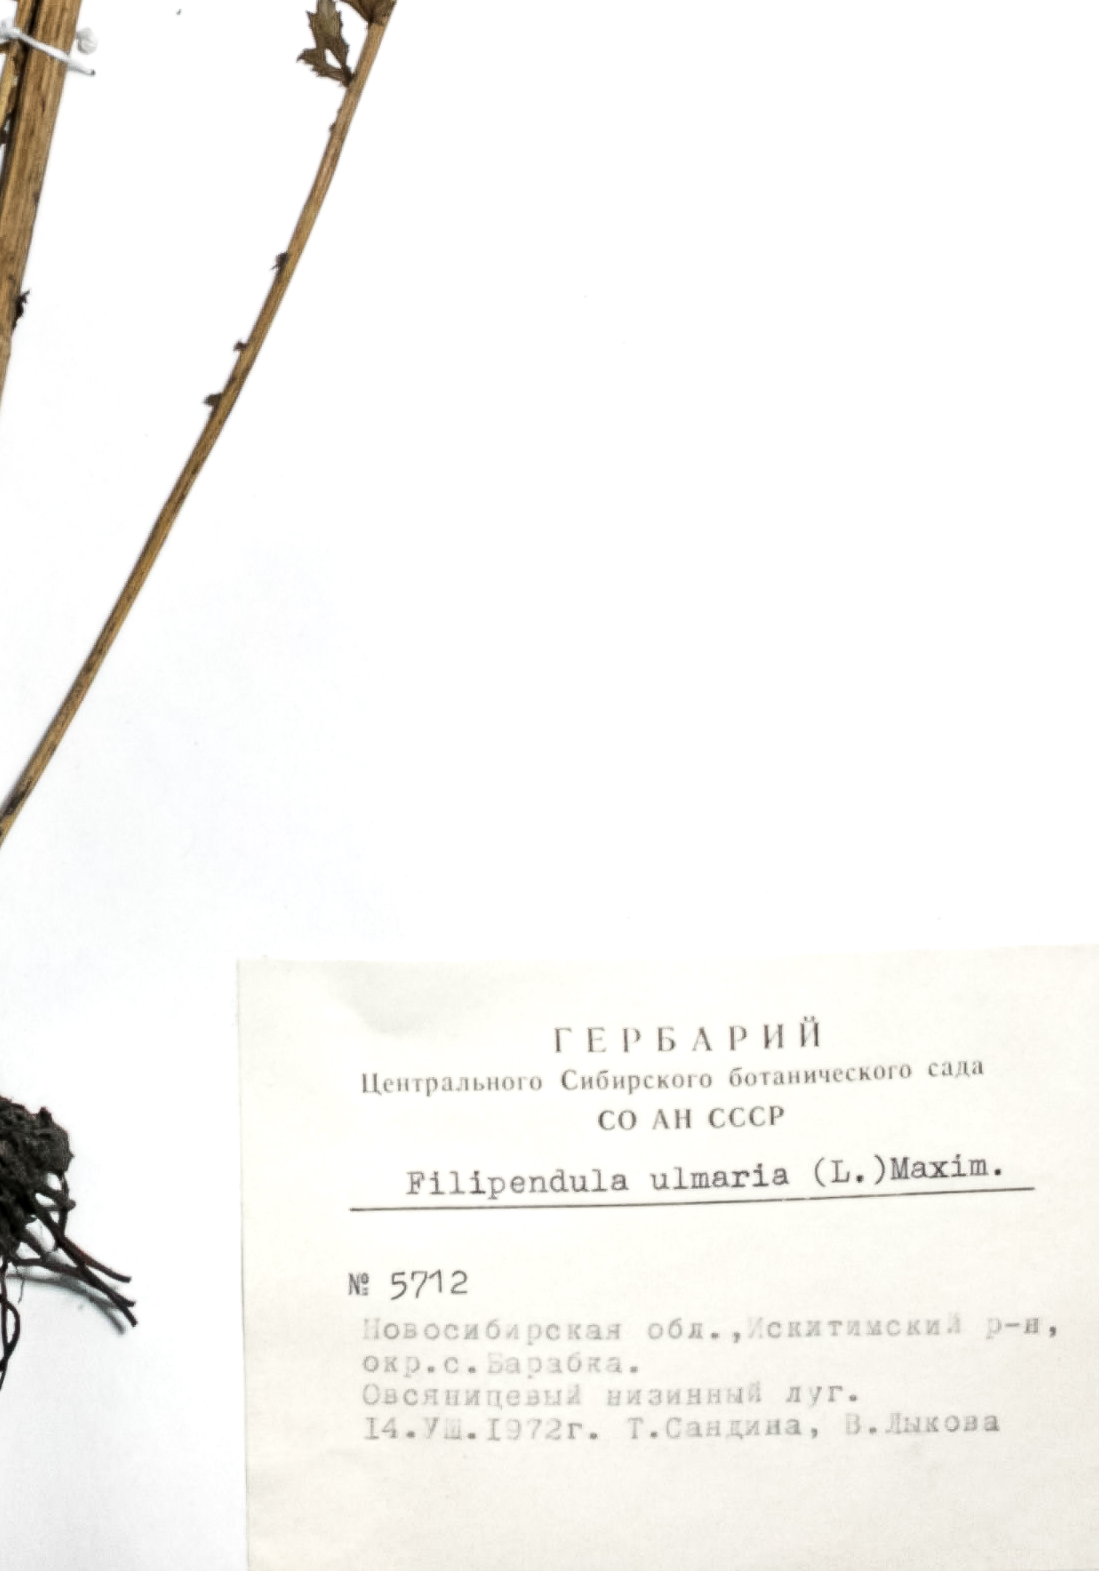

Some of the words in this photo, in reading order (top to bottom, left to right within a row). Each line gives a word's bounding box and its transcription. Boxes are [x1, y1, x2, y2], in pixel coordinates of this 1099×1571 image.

[554, 1015, 820, 1053] ГЕРБАРИЙ
[361, 1072, 543, 1097] Центрального
[560, 1069, 713, 1095] Сибирского
[728, 1063, 912, 1089] ботанического
[928, 1059, 985, 1080] сада
[597, 1109, 637, 1131] СО
[652, 1108, 692, 1130] АН
[708, 1105, 785, 1129] СССР
[405, 1168, 630, 1200] Filipendula
[650, 1162, 790, 1191] ulmaria
[348, 1272, 370, 1296] №
[390, 1269, 468, 1301] 5712
[363, 1316, 622, 1346] Новосибирская
[986, 1317, 1058, 1339] р-н,
[362, 1382, 582, 1411] Овсяницевый
[606, 1381, 762, 1408] низинный
[785, 1384, 859, 1407] луг.
